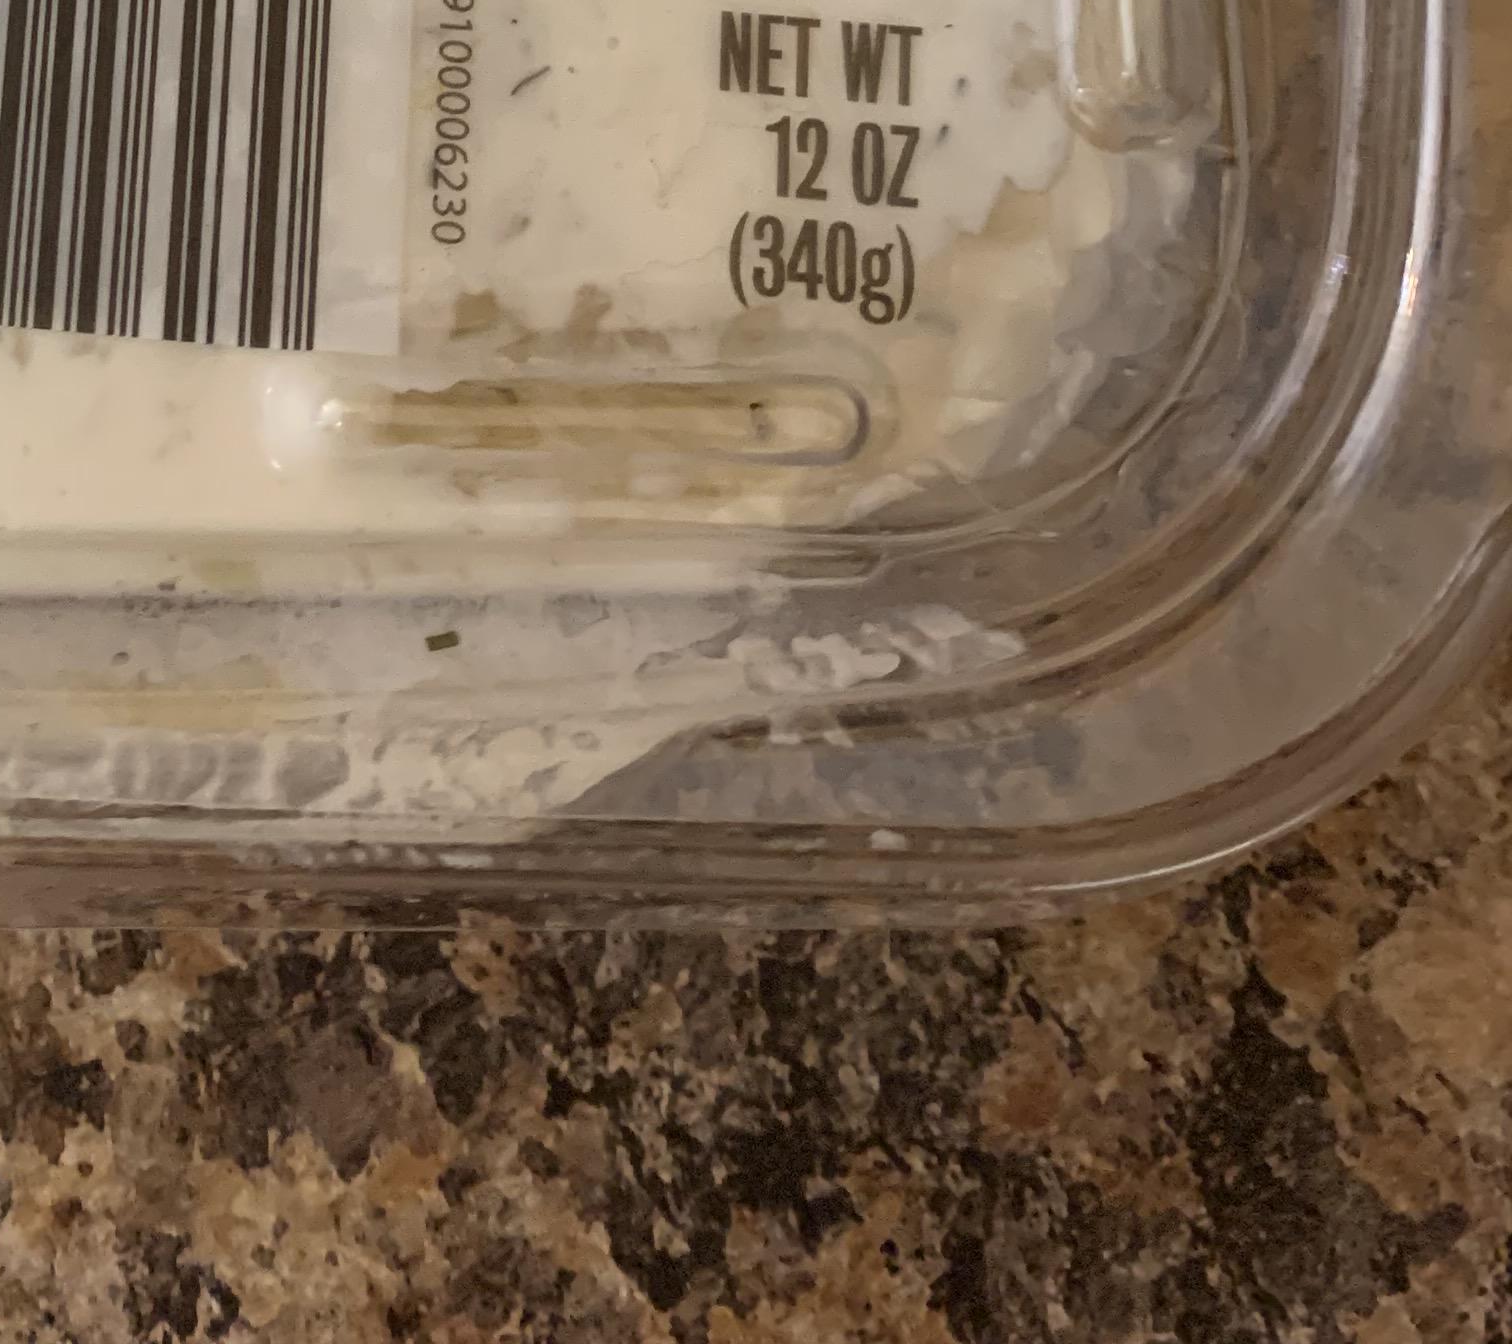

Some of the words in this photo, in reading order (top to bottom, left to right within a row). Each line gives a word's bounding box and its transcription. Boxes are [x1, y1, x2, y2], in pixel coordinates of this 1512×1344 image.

[719, 10, 821, 98] NET
[841, 20, 923, 106] WT
[765, 115, 829, 201] 12
[851, 122, 921, 208] OZ
[729, 210, 916, 325] (340g)
